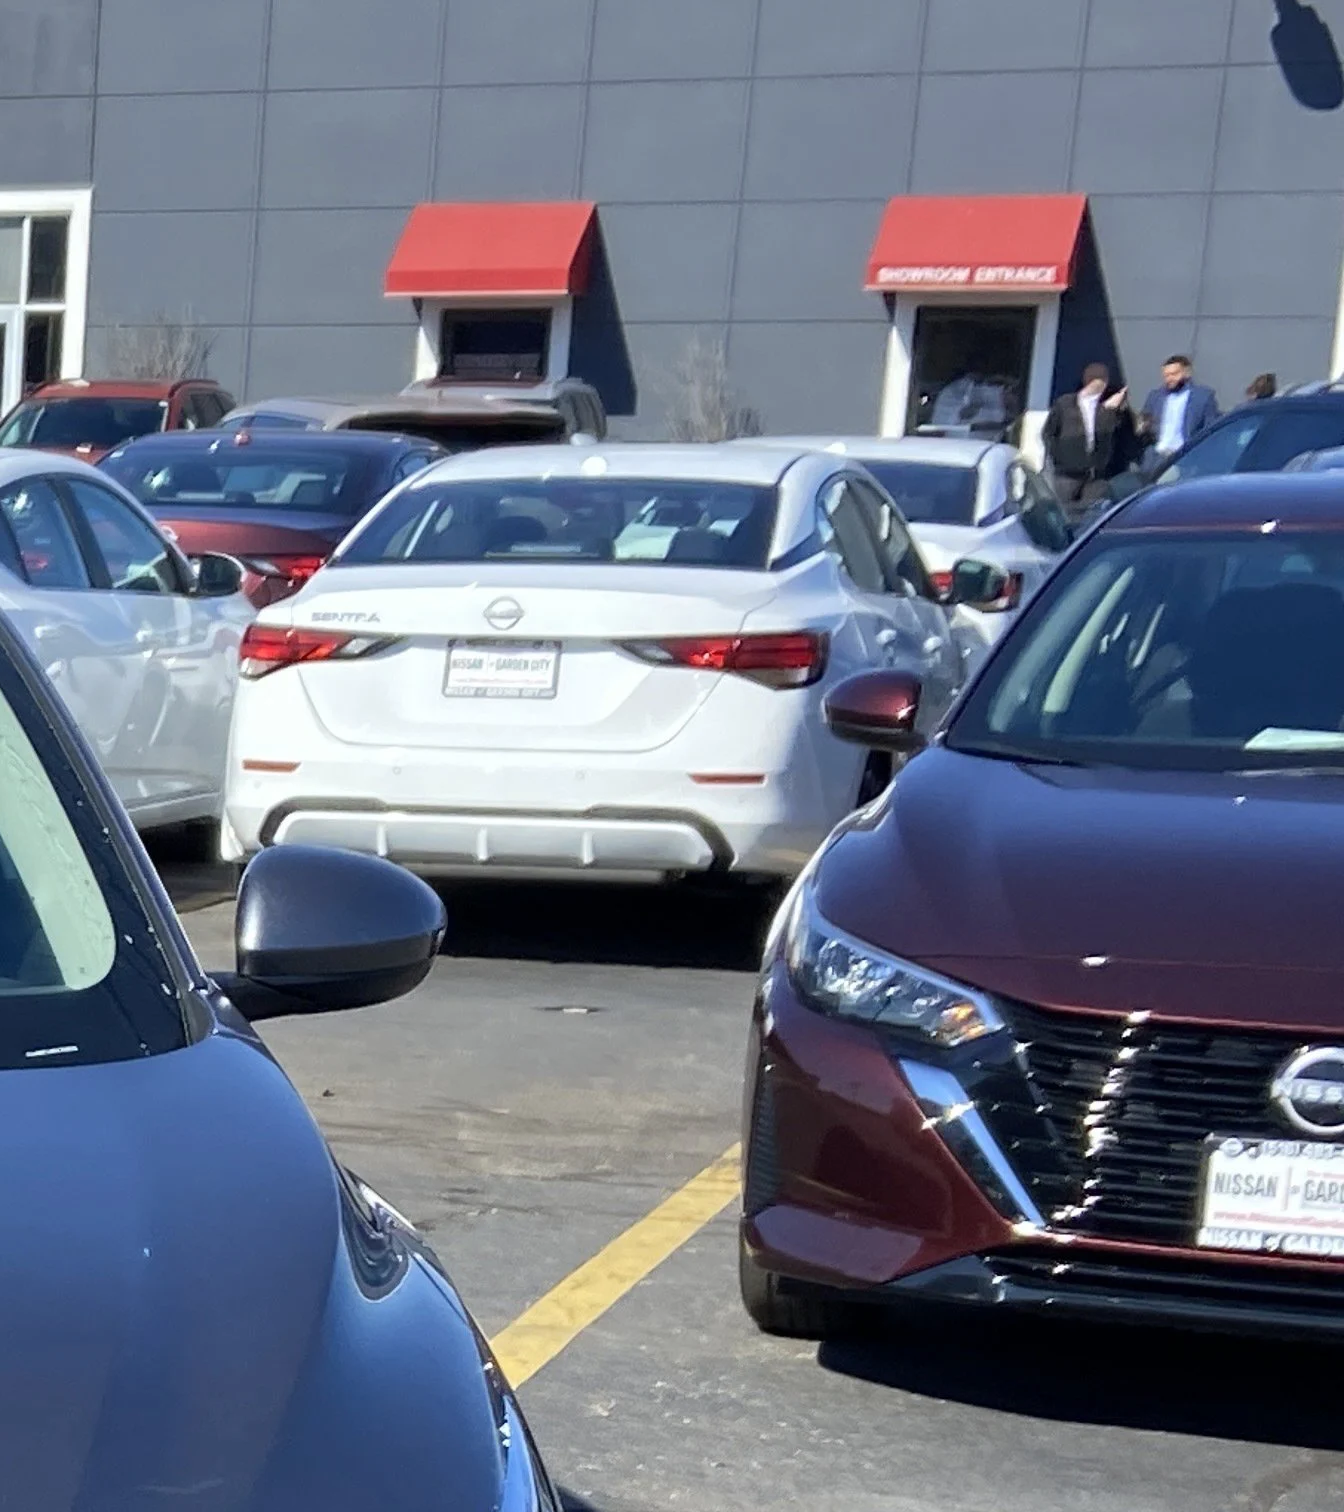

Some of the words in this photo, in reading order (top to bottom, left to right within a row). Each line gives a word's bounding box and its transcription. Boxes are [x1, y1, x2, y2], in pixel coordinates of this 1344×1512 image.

[311, 611, 381, 623] SENTRA
[1272, 1081, 1344, 1104] NISS
[1214, 1172, 1279, 1198] NISSAN
[1304, 1179, 1344, 1204] GAR
